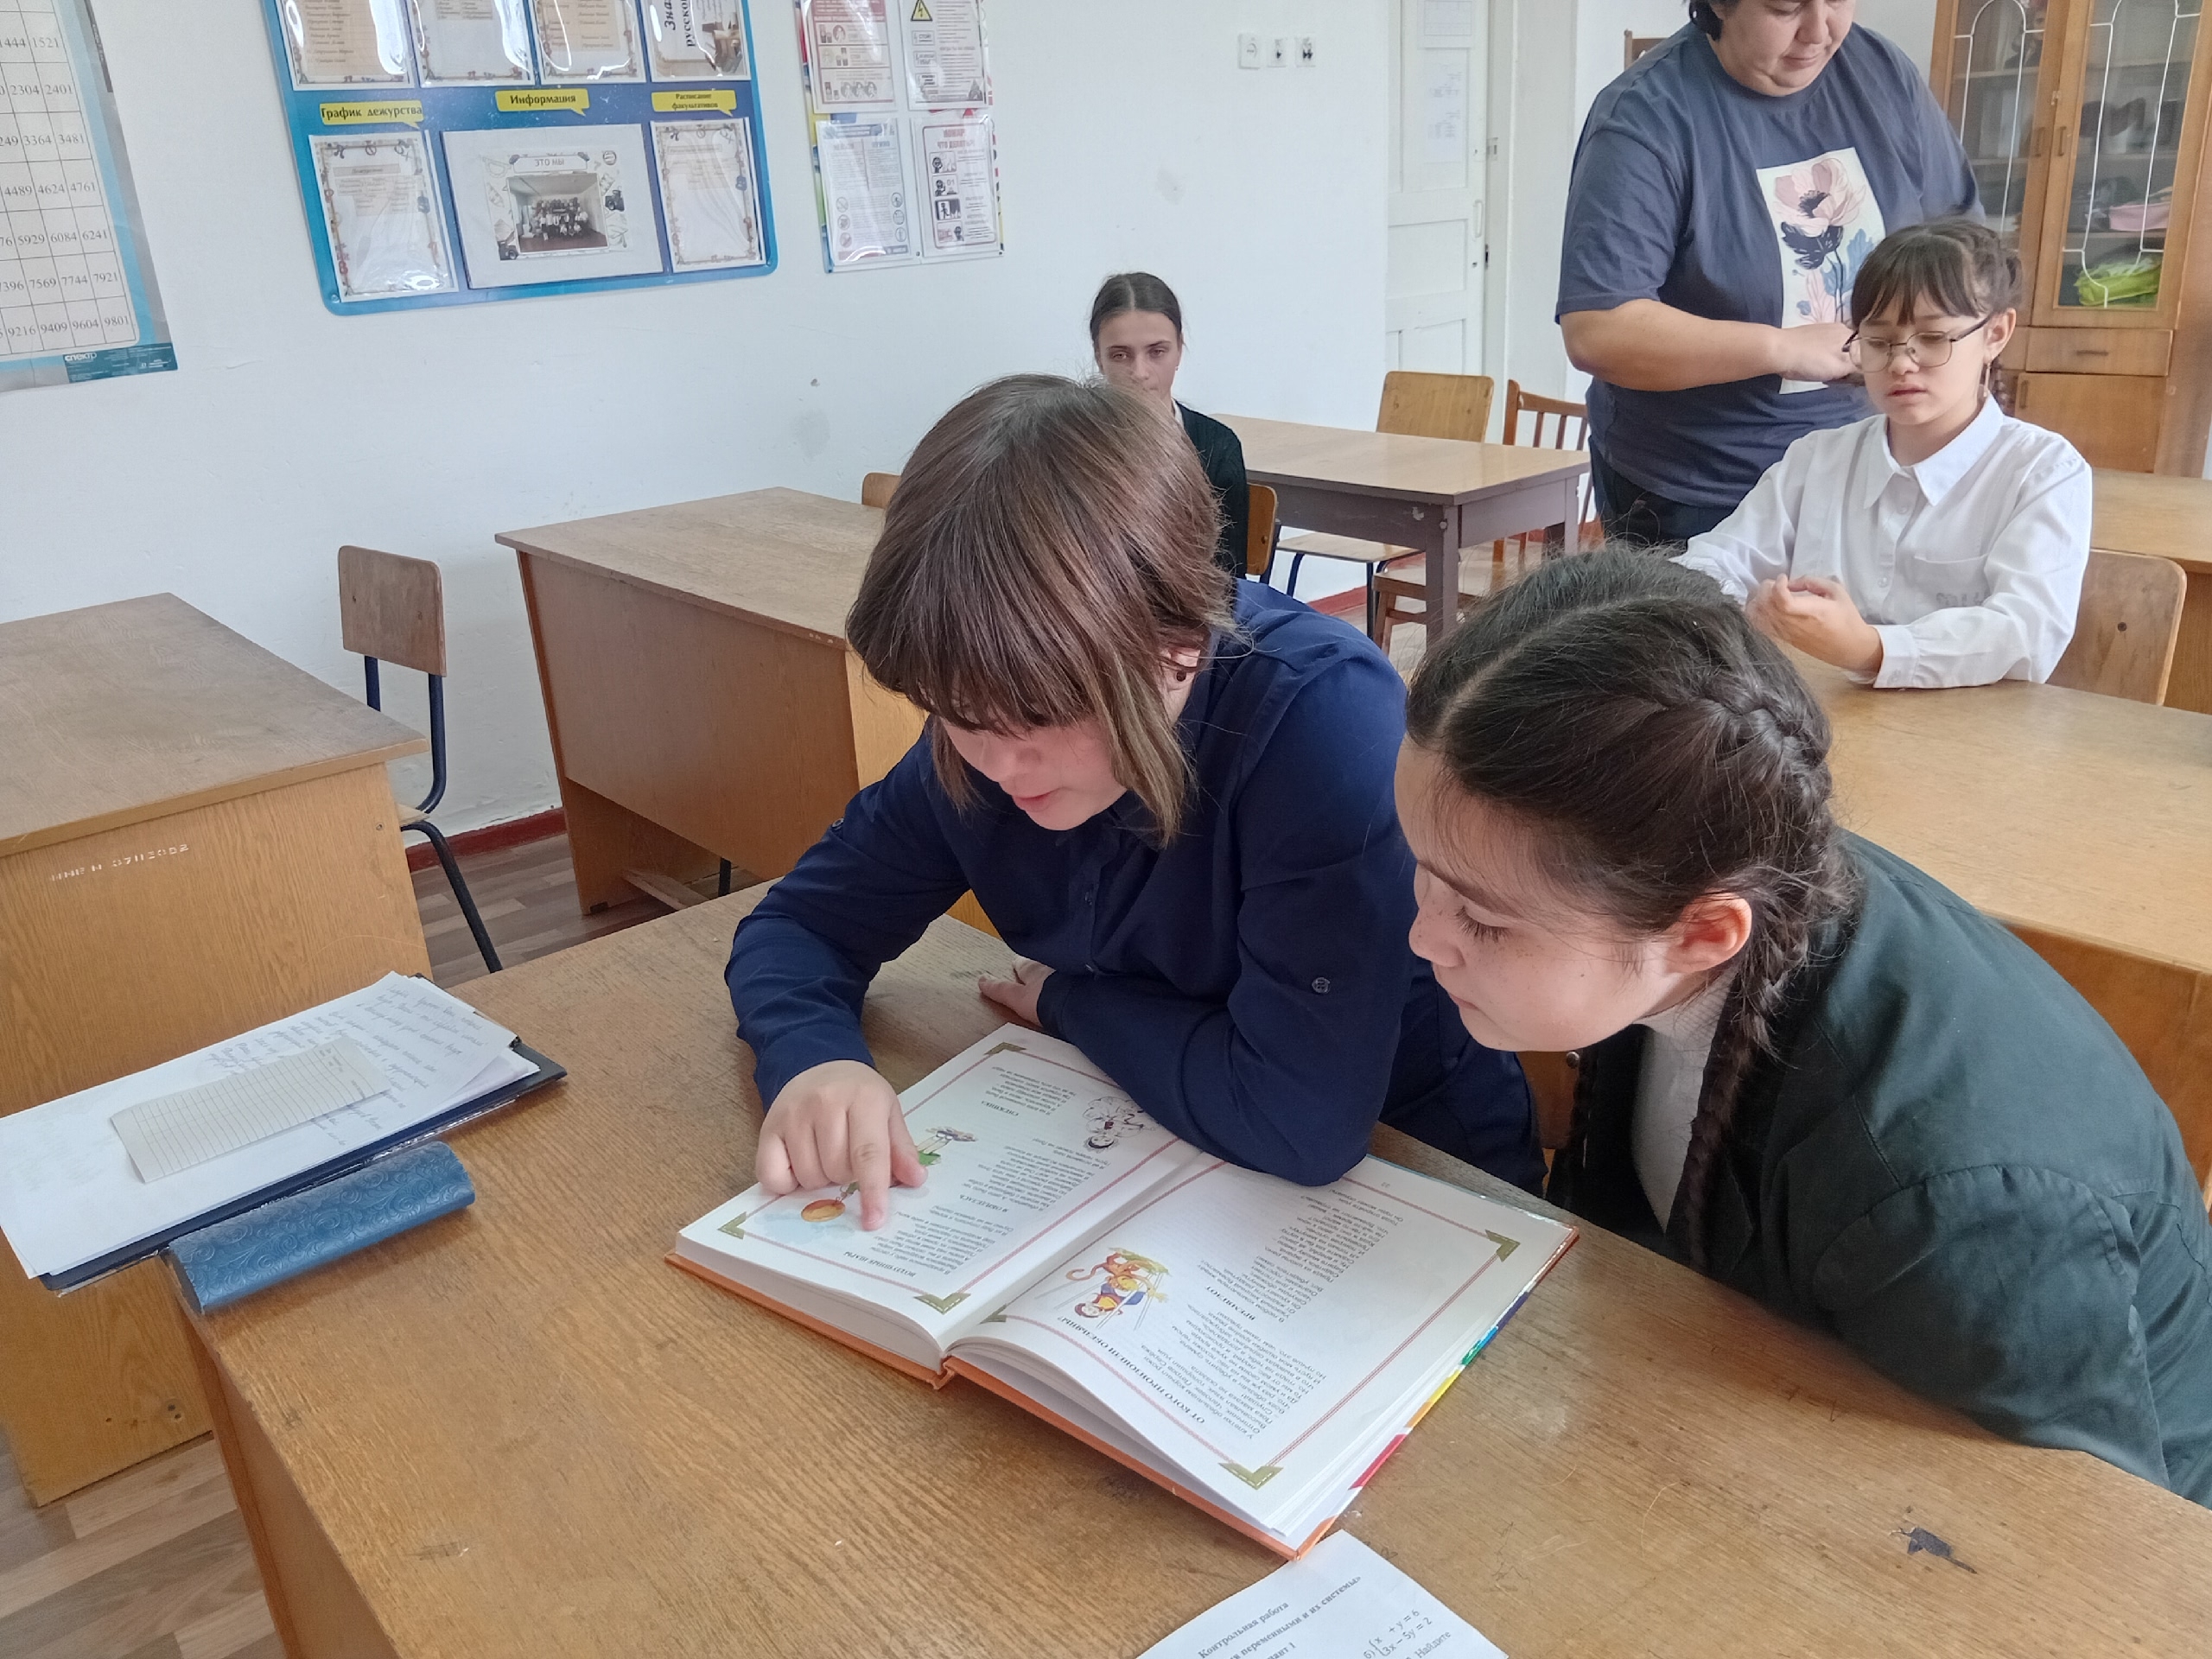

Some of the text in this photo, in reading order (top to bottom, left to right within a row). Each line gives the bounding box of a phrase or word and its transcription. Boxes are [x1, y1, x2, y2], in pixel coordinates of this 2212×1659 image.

[664, 0, 676, 30] Зна
[681, 0, 696, 47] русско
[33, 37, 59, 48] 1521
[10, 85, 39, 95] 2304
[46, 84, 73, 95] 2401
[510, 94, 576, 106] Информация
[321, 106, 423, 120] График дежурства
[0, 135, 18, 146] 249
[22, 135, 52, 146] 3364
[58, 133, 85, 145] 3481
[4, 186, 33, 197] 4489
[37, 183, 66, 194] 4624
[70, 182, 96, 193] 4761
[17, 234, 45, 245] 5929
[50, 232, 77, 243] 6084
[82, 229, 107, 240] 6241
[60, 275, 88, 286] 7744
[93, 272, 118, 283] 7921
[29, 278, 57, 289] 7569
[72, 319, 99, 330] 9604
[104, 315, 130, 326] 9801
[7, 326, 36, 337] 9216
[41, 322, 68, 334] 9409
[1107, 1347, 1165, 1393] ПРОИЗОШЛИ
[1163, 1392, 1191, 1413] КОГО
[1198, 1602, 1289, 1659] Контрольная работа
[1240, 1617, 1302, 1656] переменными
[1309, 1605, 1321, 1614] их
[1414, 1630, 1452, 1659] Найдите
